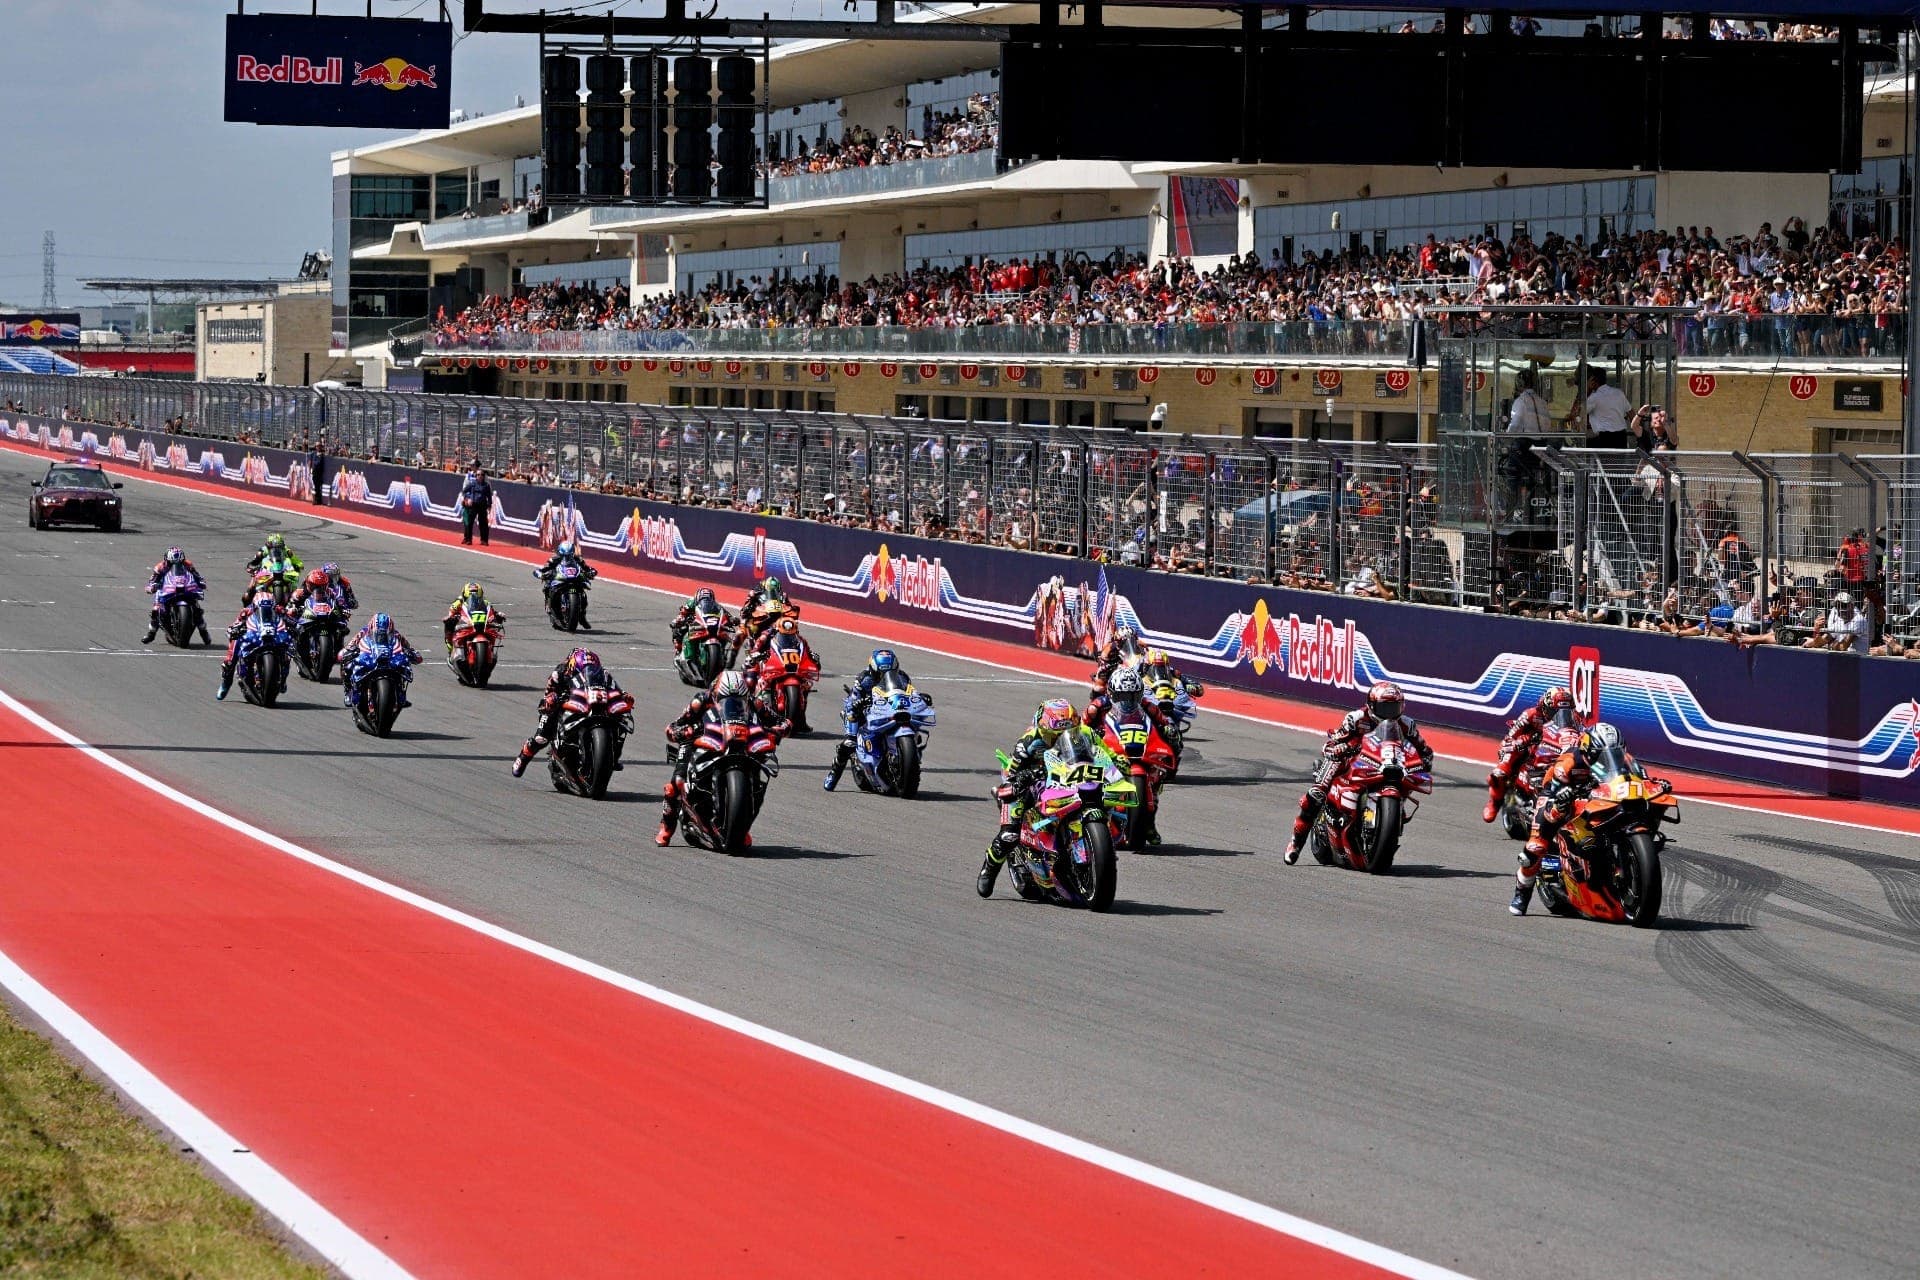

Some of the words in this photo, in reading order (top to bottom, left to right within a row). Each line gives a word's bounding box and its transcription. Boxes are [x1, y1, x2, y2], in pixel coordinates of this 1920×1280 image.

[237, 55, 290, 82] Red
[292, 57, 342, 84] Bull
[729, 361, 737, 372] 12
[813, 363, 822, 373] 13
[848, 364, 856, 374] 14
[885, 365, 893, 375] 15
[924, 366, 932, 376] 16
[965, 366, 973, 377] 17
[1011, 367, 1020, 378] 18
[1144, 368, 1153, 380] 19
[1200, 368, 1212, 382] 20
[1259, 369, 1271, 383] 21
[1323, 371, 1335, 385] 22
[1391, 372, 1405, 386] 23
[1695, 376, 1710, 393] 25
[1796, 378, 1811, 395] 26
[899, 553, 921, 608] Red
[918, 554, 942, 612] Bull
[781, 652, 800, 665] 10
[1288, 613, 1322, 681] Red
[1320, 619, 1355, 690] Bull
[1572, 658, 1595, 718] QT
[1119, 730, 1148, 744] 36
[1066, 764, 1104, 784] 49
[1617, 781, 1643, 799] 37
